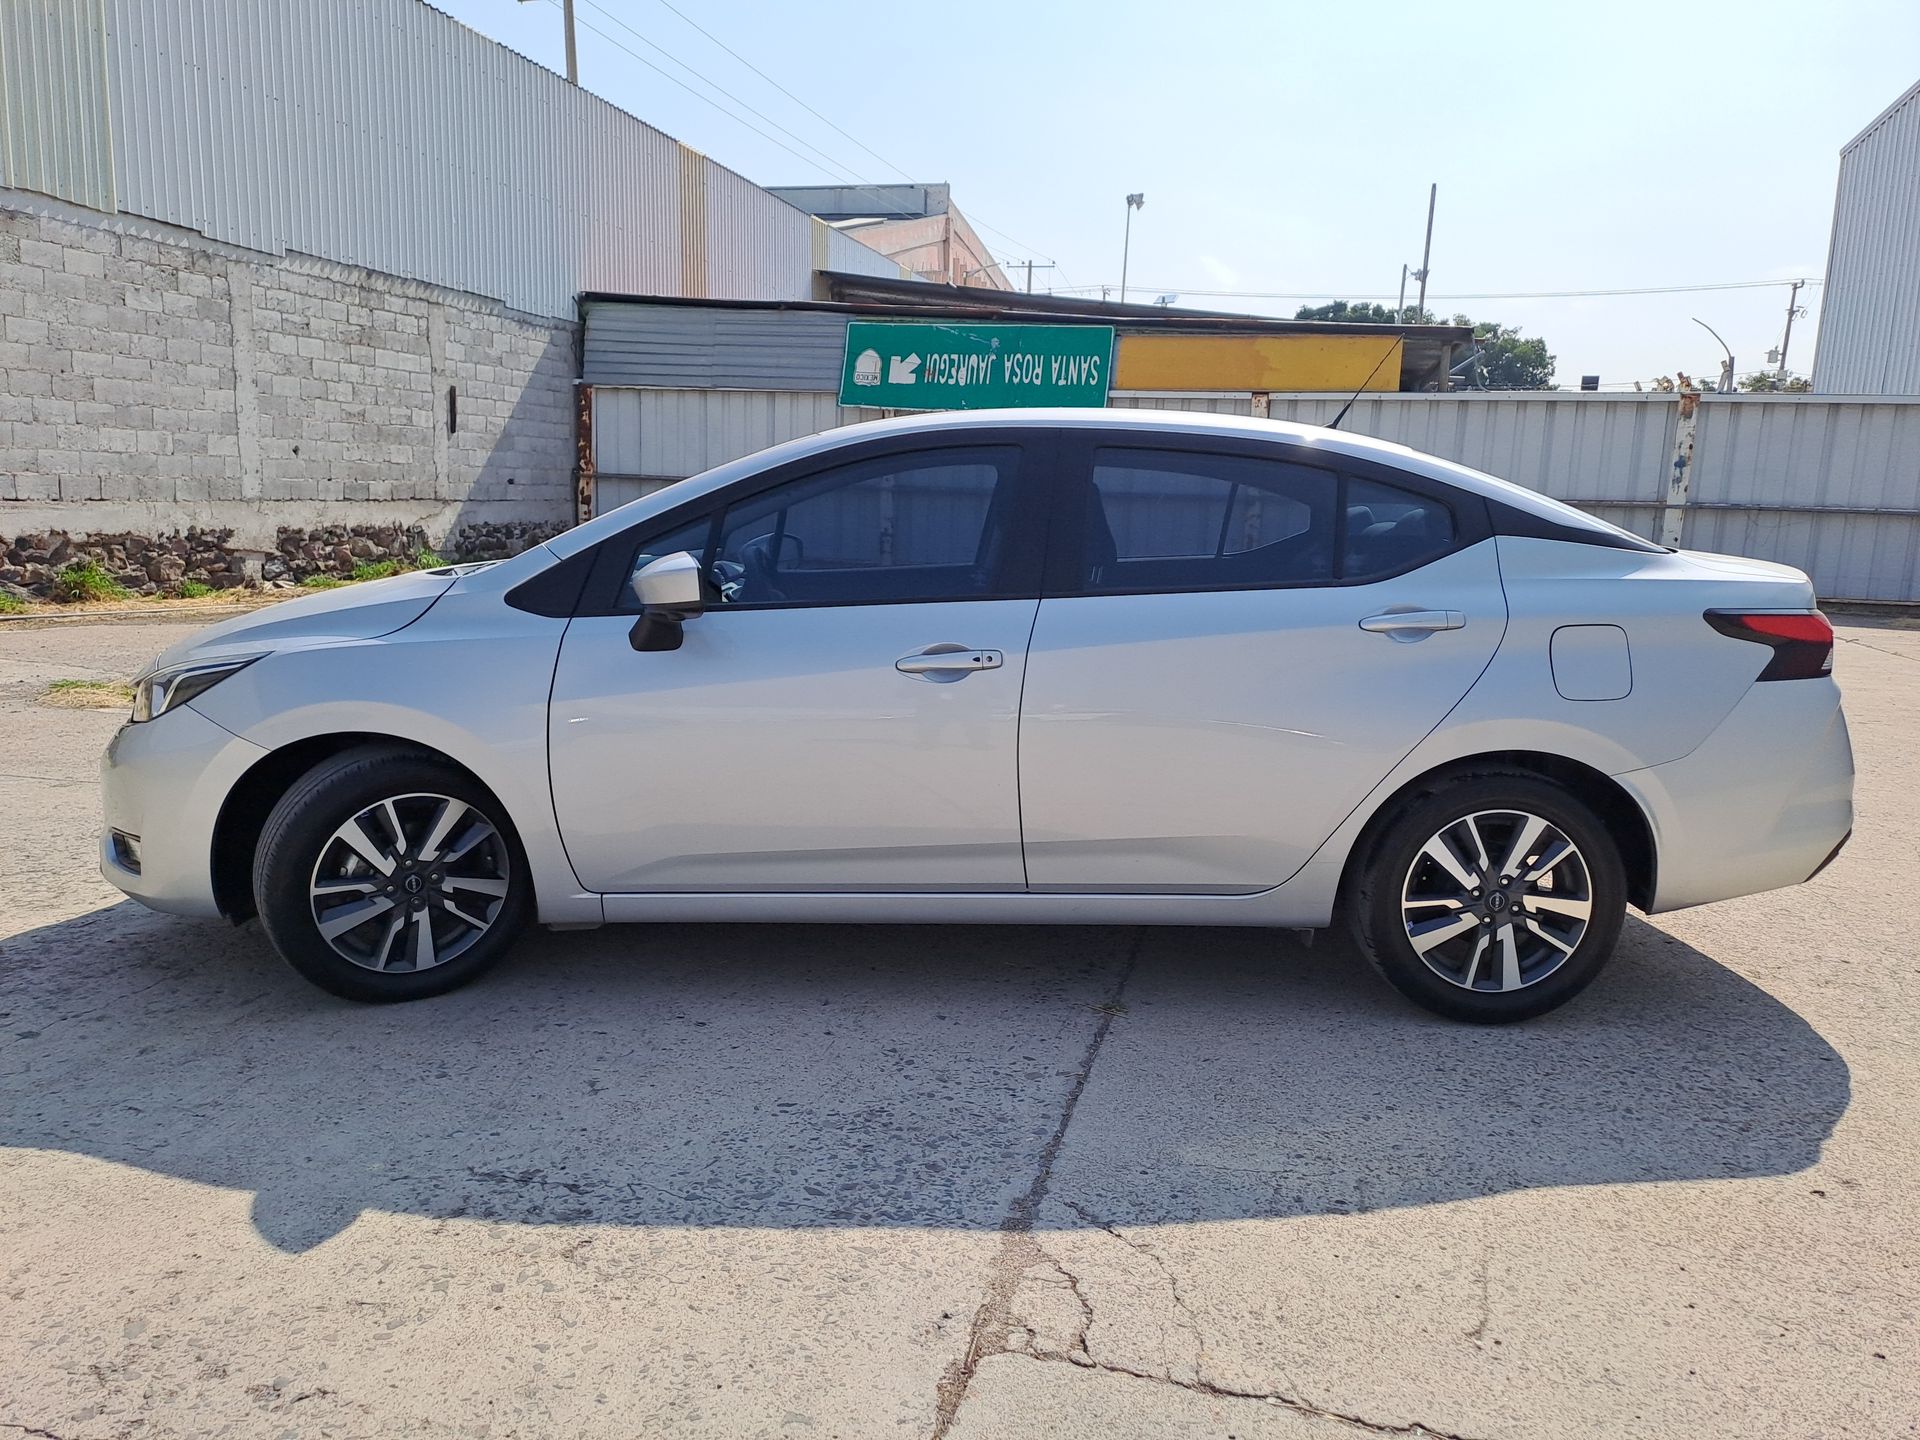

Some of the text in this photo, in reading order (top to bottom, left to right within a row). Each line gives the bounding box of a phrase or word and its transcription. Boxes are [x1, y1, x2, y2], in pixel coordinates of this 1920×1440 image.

[924, 353, 1100, 386] SANTA ROSA JAUREGUI
